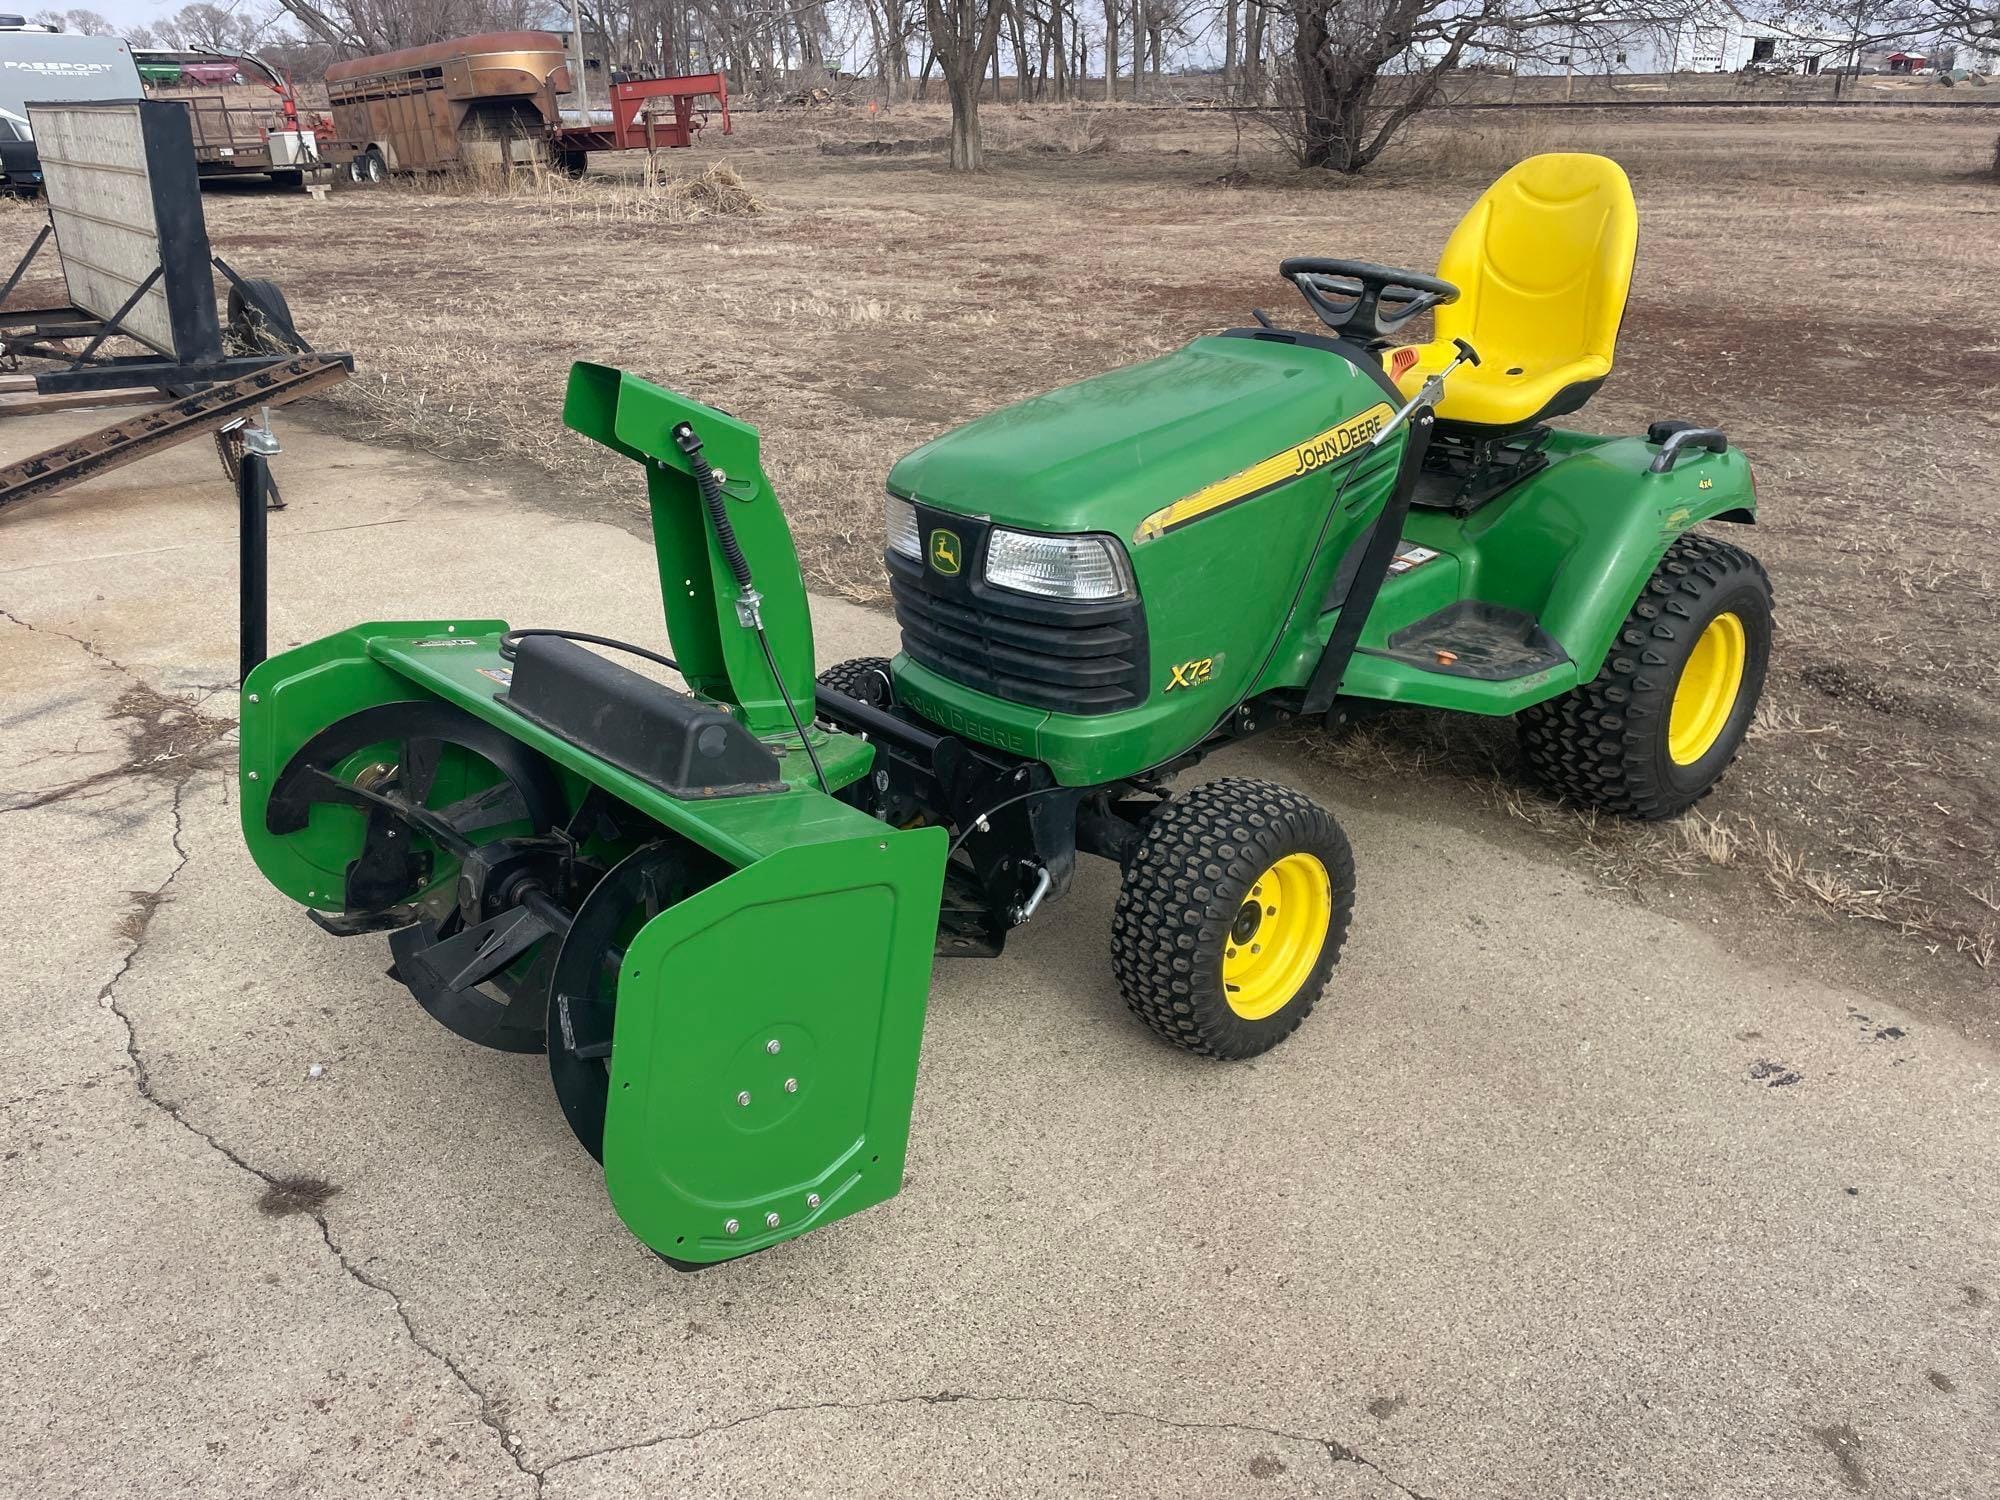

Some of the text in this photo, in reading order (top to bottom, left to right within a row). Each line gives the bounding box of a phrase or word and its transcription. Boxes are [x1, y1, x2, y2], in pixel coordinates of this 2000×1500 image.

[4, 61, 112, 72] PASSPORT
[1296, 415, 1383, 473] JOHN DEERE
[950, 709, 1024, 753] DEERE
